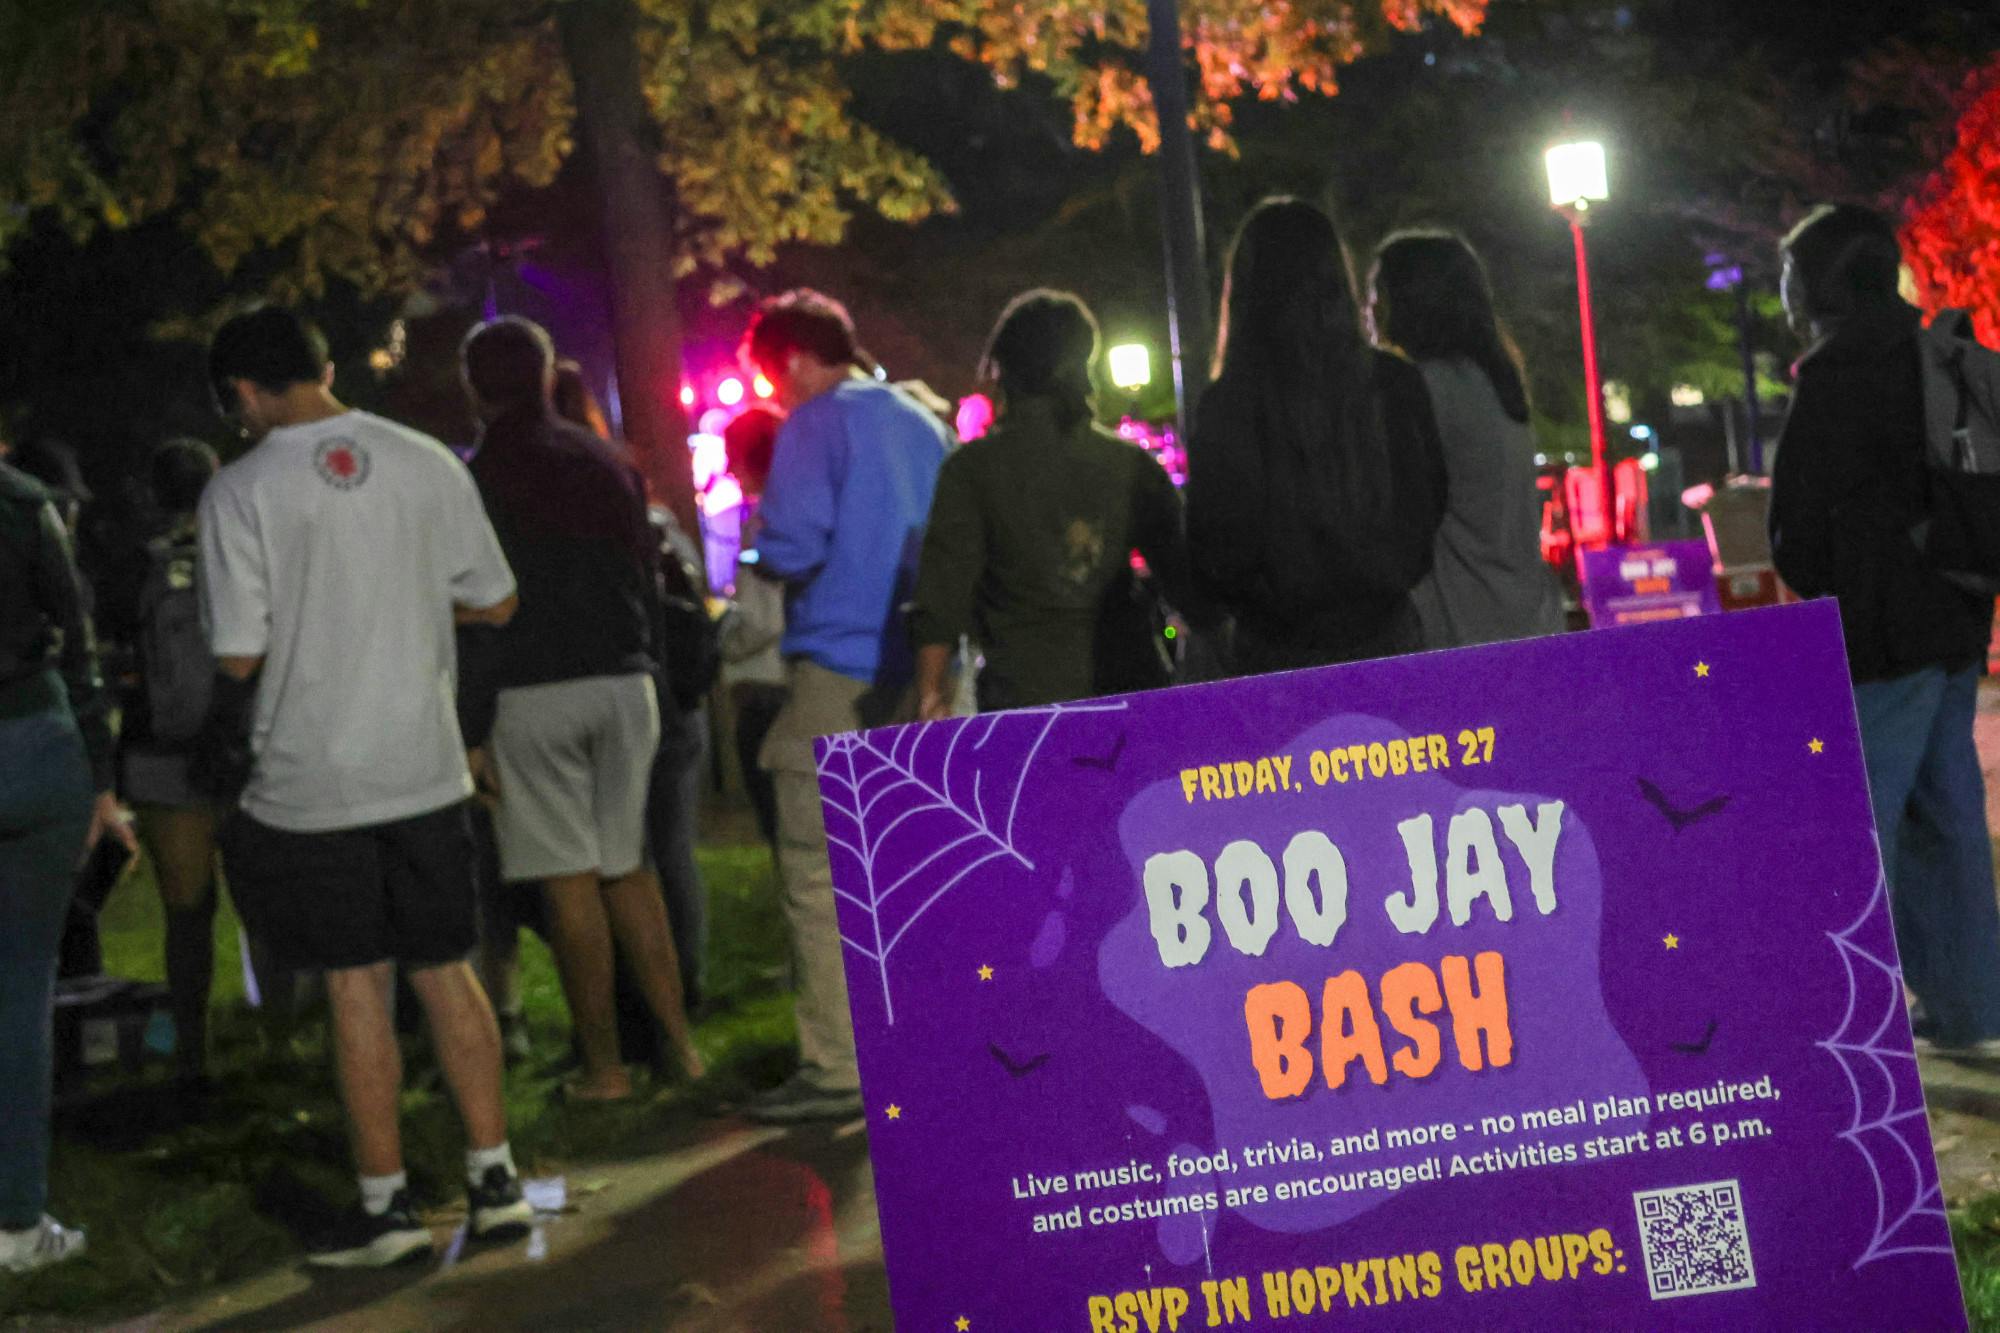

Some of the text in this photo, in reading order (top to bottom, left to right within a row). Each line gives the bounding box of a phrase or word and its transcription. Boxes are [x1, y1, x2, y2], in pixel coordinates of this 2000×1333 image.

[1180, 727, 1497, 803] FRIDAY, OCTOBER 27
[1143, 800, 1564, 968] BOO JAY
[1244, 951, 1513, 1100] BASH
[1012, 1173, 1068, 1199] Live
[1075, 1160, 1162, 1190] music,
[1167, 1149, 1238, 1178] food,
[1243, 1138, 1324, 1168] trivia,
[1330, 1128, 1380, 1156] and
[1387, 1120, 1457, 1149] more
[1481, 1113, 1515, 1136] no
[1522, 1100, 1587, 1130] meal
[1593, 1095, 1650, 1125] plan
[1656, 1075, 1782, 1113] required,
[1032, 1115, 1772, 1233] and costumes are encouraged! Activities start at 6 p.m.
[1087, 1228, 1627, 1333] RSVP IN HOPKINS GROUPS:
